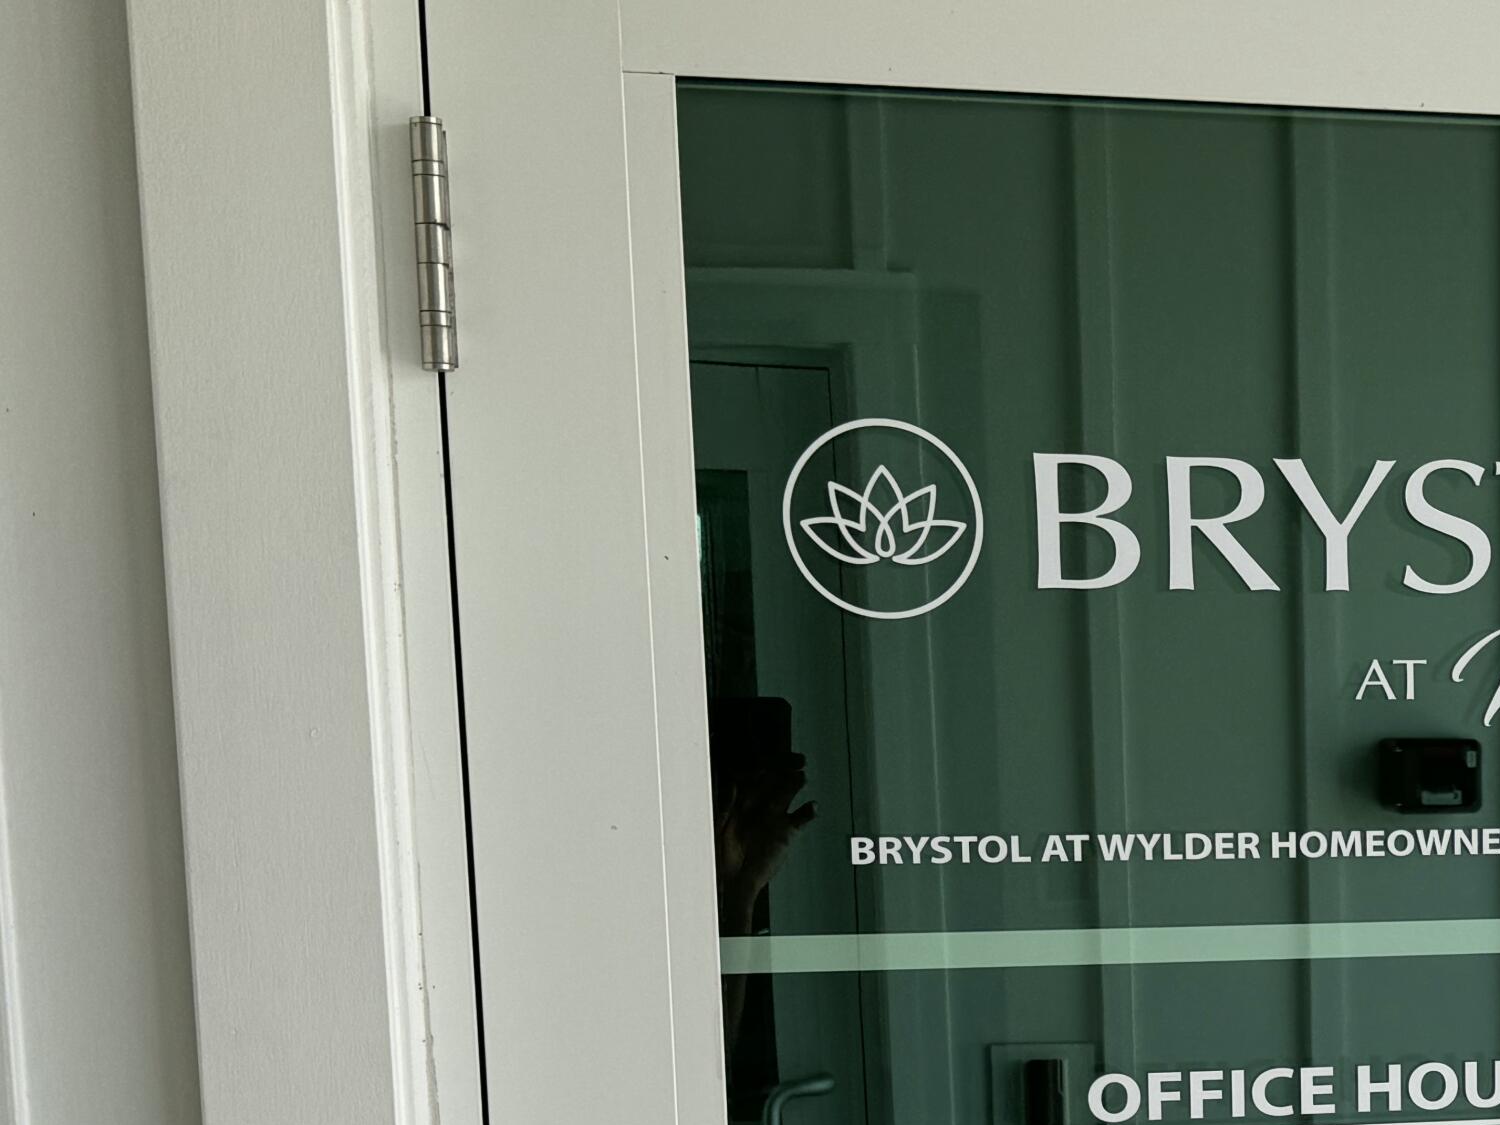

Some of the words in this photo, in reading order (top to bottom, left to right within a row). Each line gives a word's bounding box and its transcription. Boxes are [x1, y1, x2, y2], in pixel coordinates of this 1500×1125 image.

[1355, 659, 1427, 700] AT
[850, 835, 1032, 865] BRYSTOL
[1041, 834, 1090, 862] AT
[1097, 832, 1261, 861] WYLDER
[1087, 1066, 1336, 1123] OFFICE
